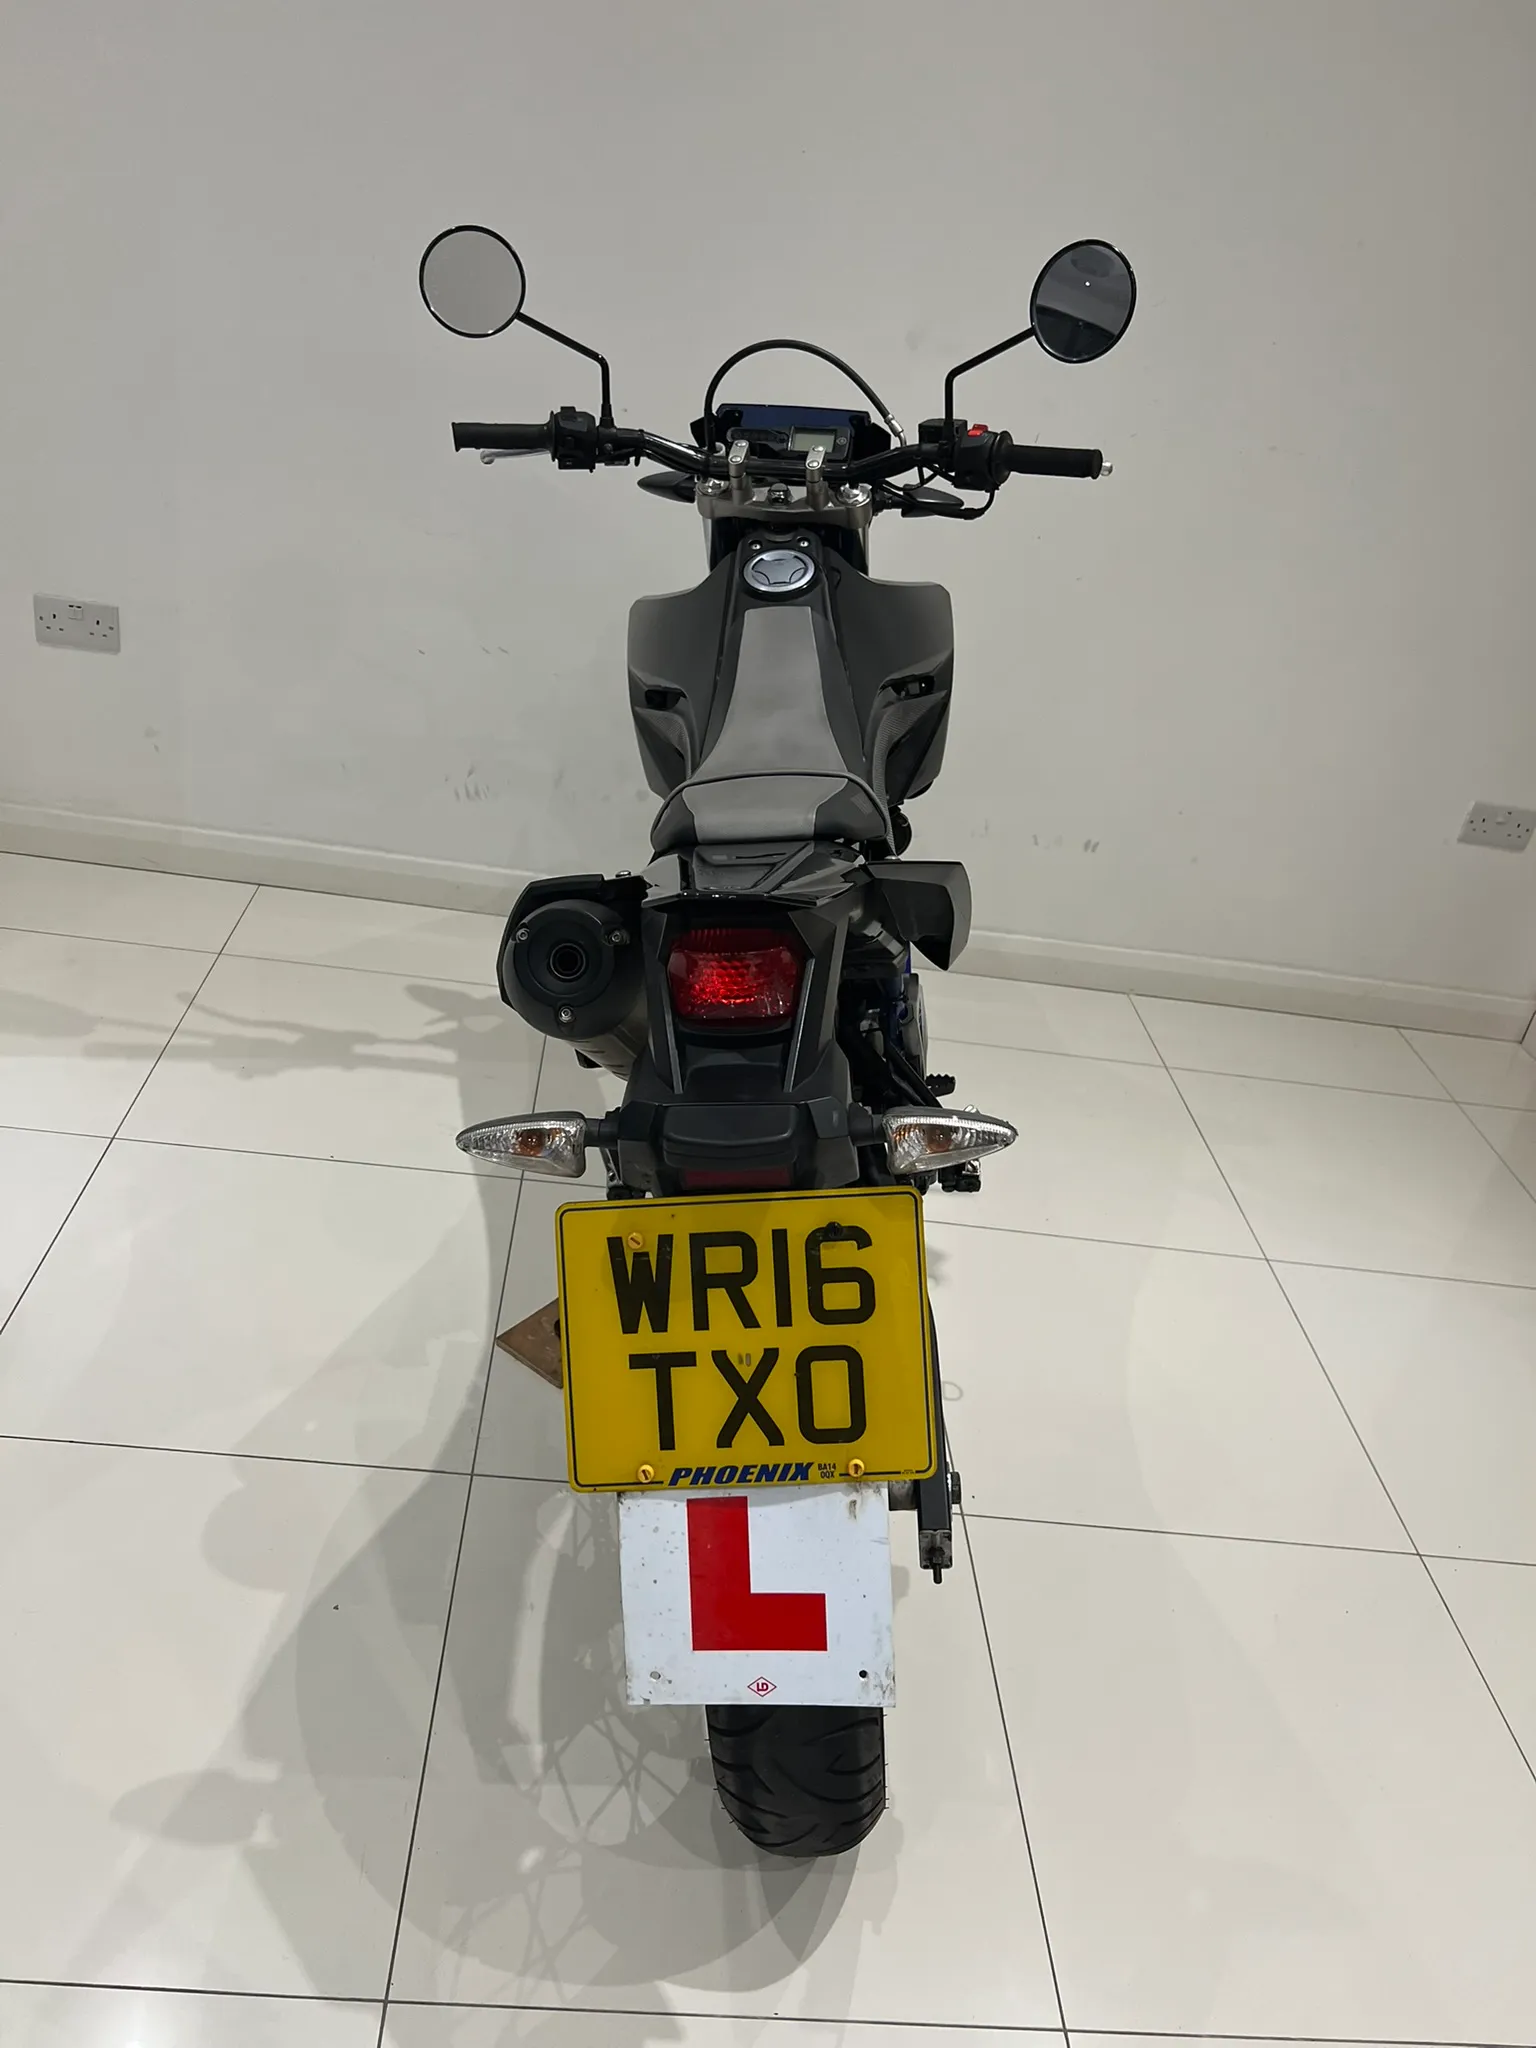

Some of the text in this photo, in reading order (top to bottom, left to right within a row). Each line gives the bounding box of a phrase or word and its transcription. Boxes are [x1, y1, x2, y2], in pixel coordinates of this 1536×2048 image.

[606, 1225, 876, 1334] WR16
[628, 1344, 867, 1451] TXO
[668, 1462, 814, 1486] PHOENIX
[817, 1463, 837, 1471] BA14
[686, 1496, 828, 1651] L
